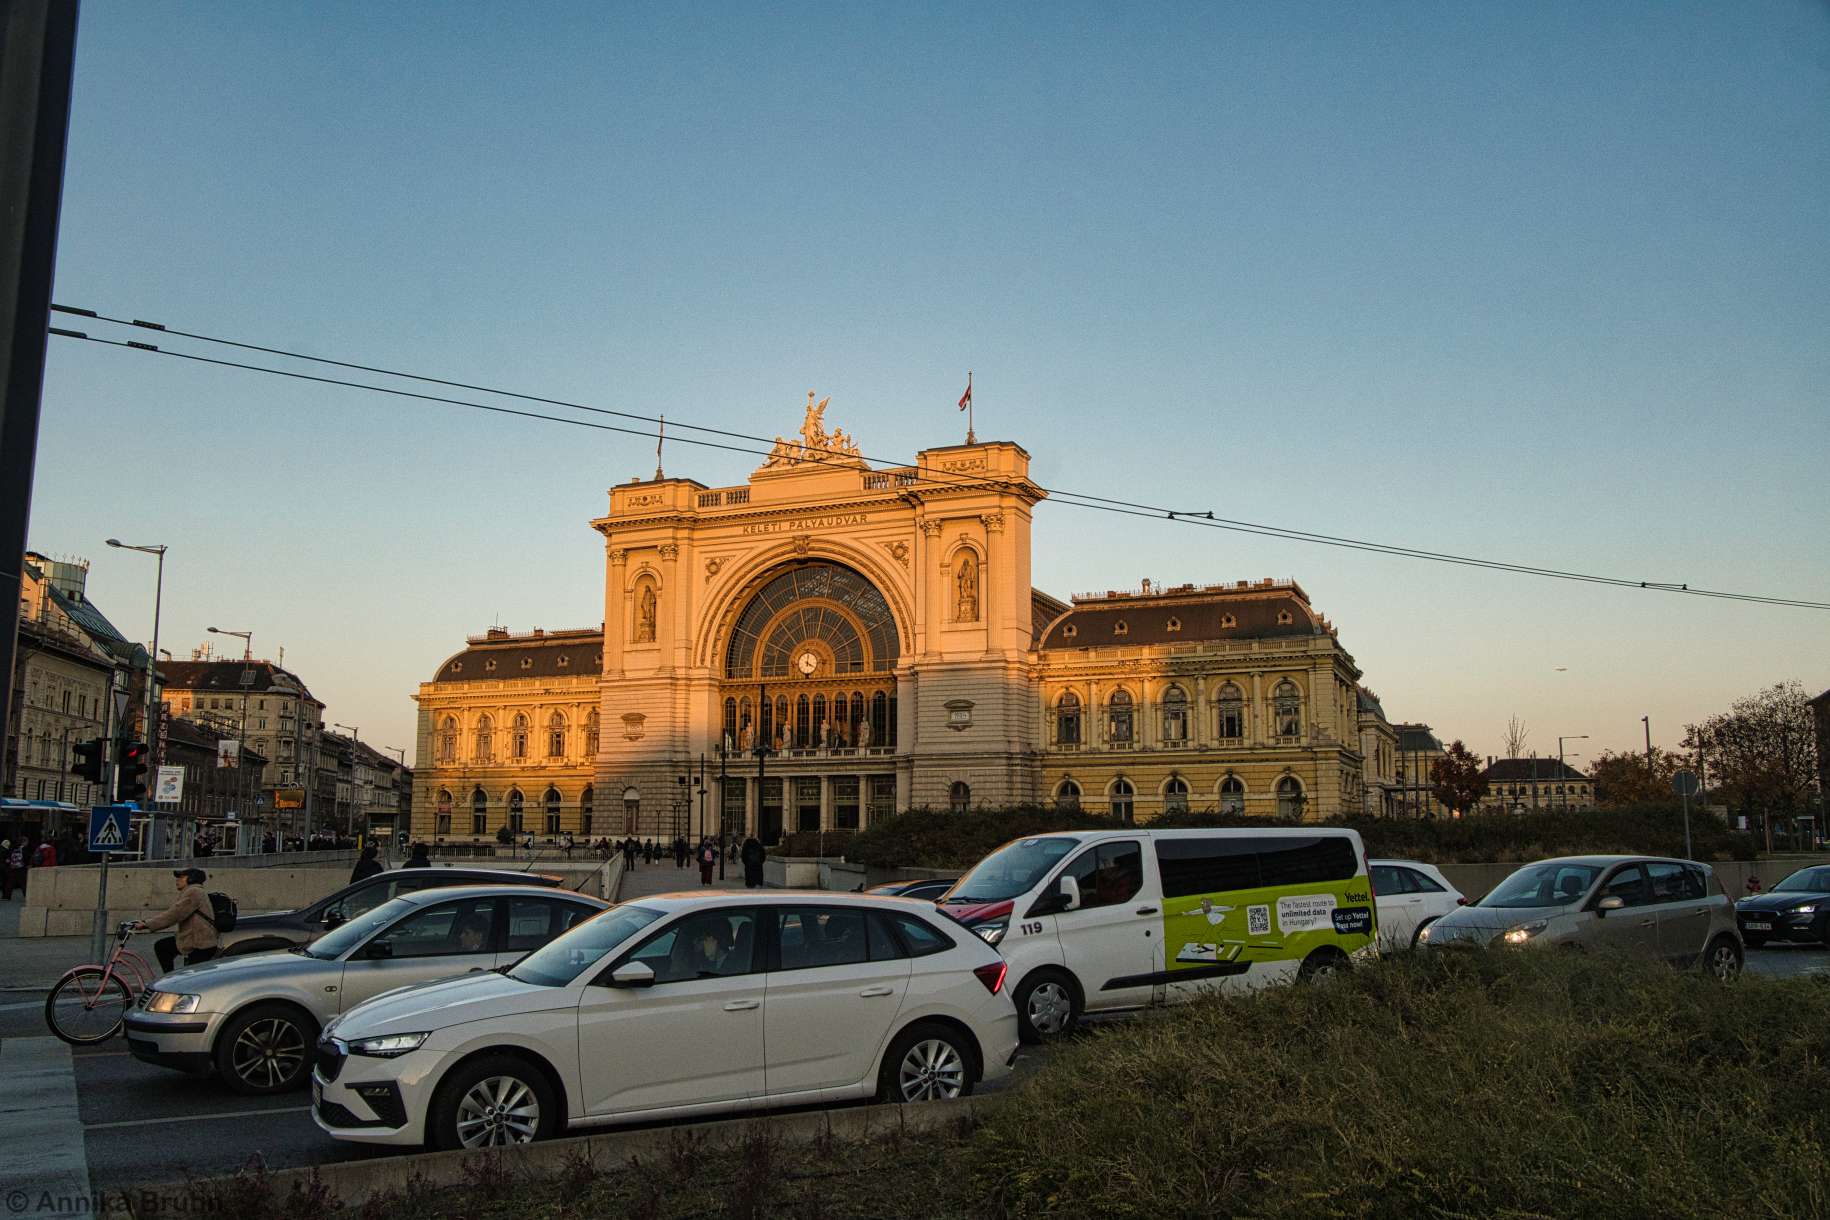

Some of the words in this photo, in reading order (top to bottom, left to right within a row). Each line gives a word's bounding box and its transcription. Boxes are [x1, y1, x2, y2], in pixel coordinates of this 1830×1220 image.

[743, 522, 782, 535] KELETI
[1292, 900, 1311, 909] fastest
[1281, 909, 1312, 918] unlimited
[1312, 908, 1327, 916] data
[1334, 913, 1344, 921] Set
[1352, 911, 1369, 919] Yettel
[1020, 921, 1043, 936] 119
